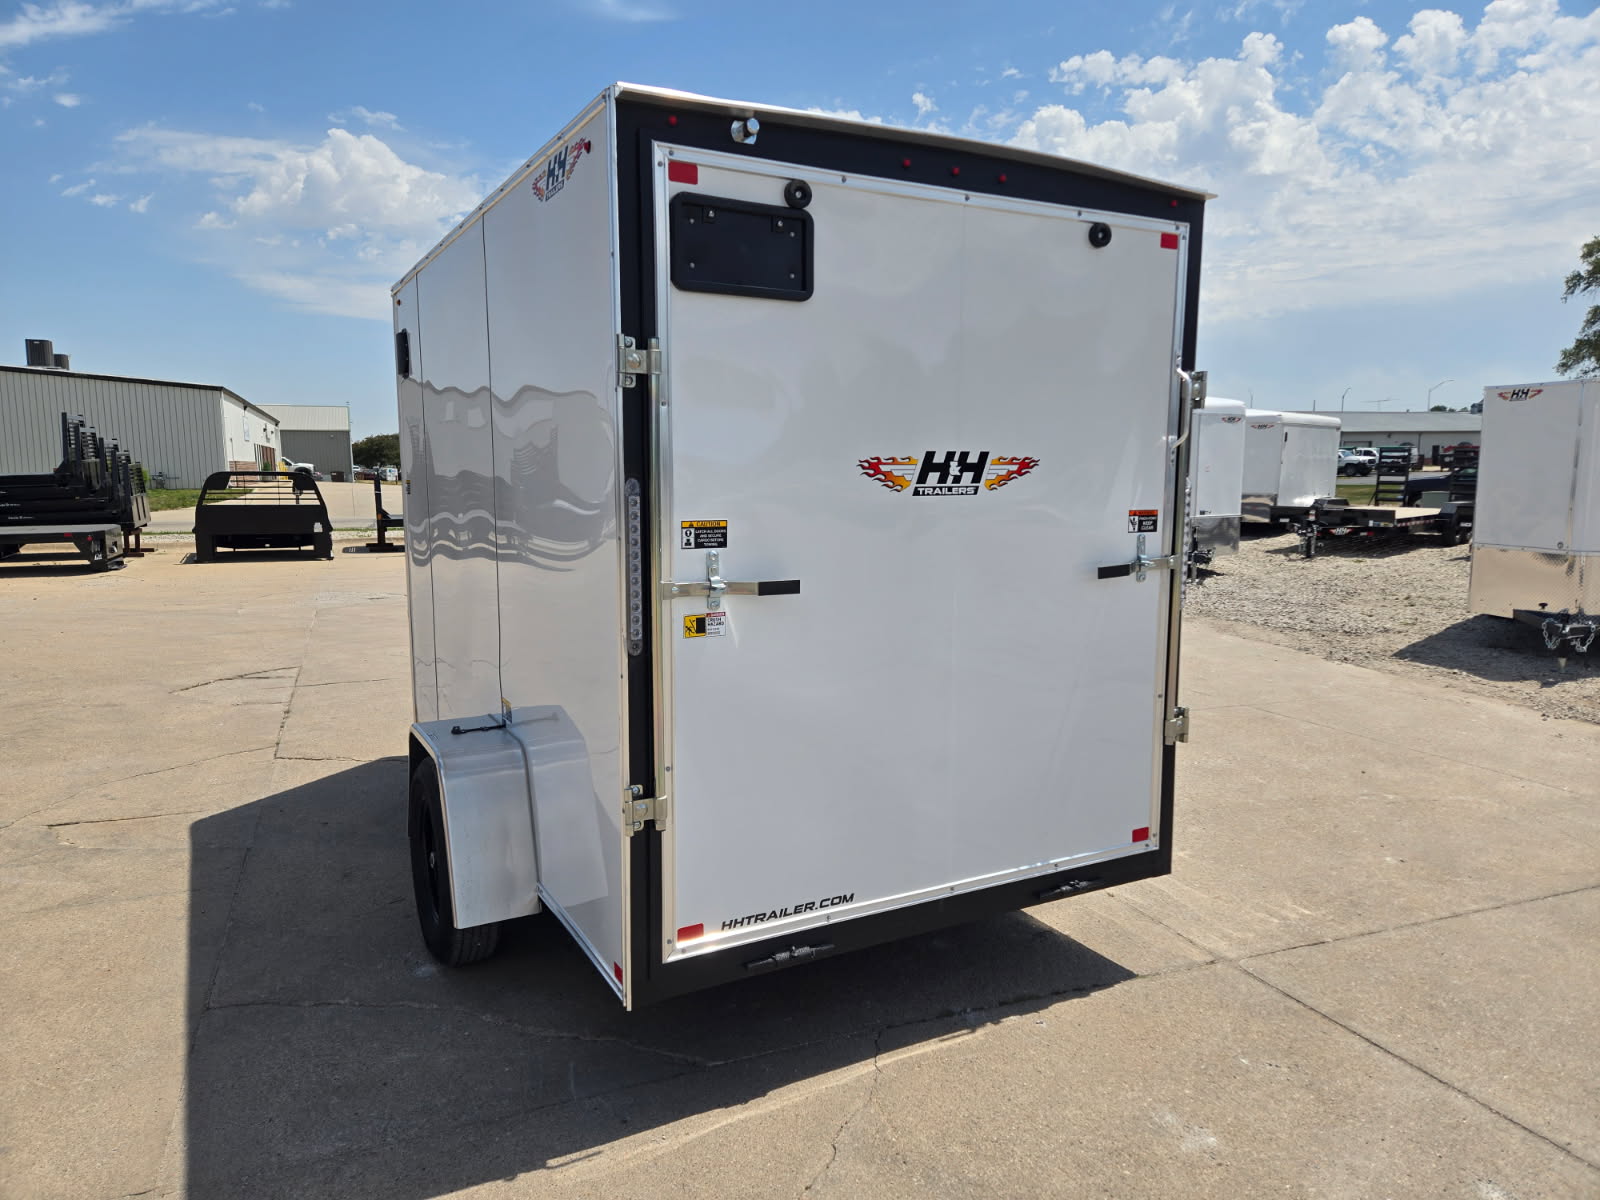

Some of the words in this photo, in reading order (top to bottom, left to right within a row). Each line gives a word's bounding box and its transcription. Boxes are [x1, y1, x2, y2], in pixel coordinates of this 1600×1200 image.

[916, 451, 990, 485] H&H
[917, 487, 976, 495] TRAILERS
[721, 893, 855, 931] HHTRAILER.COM
